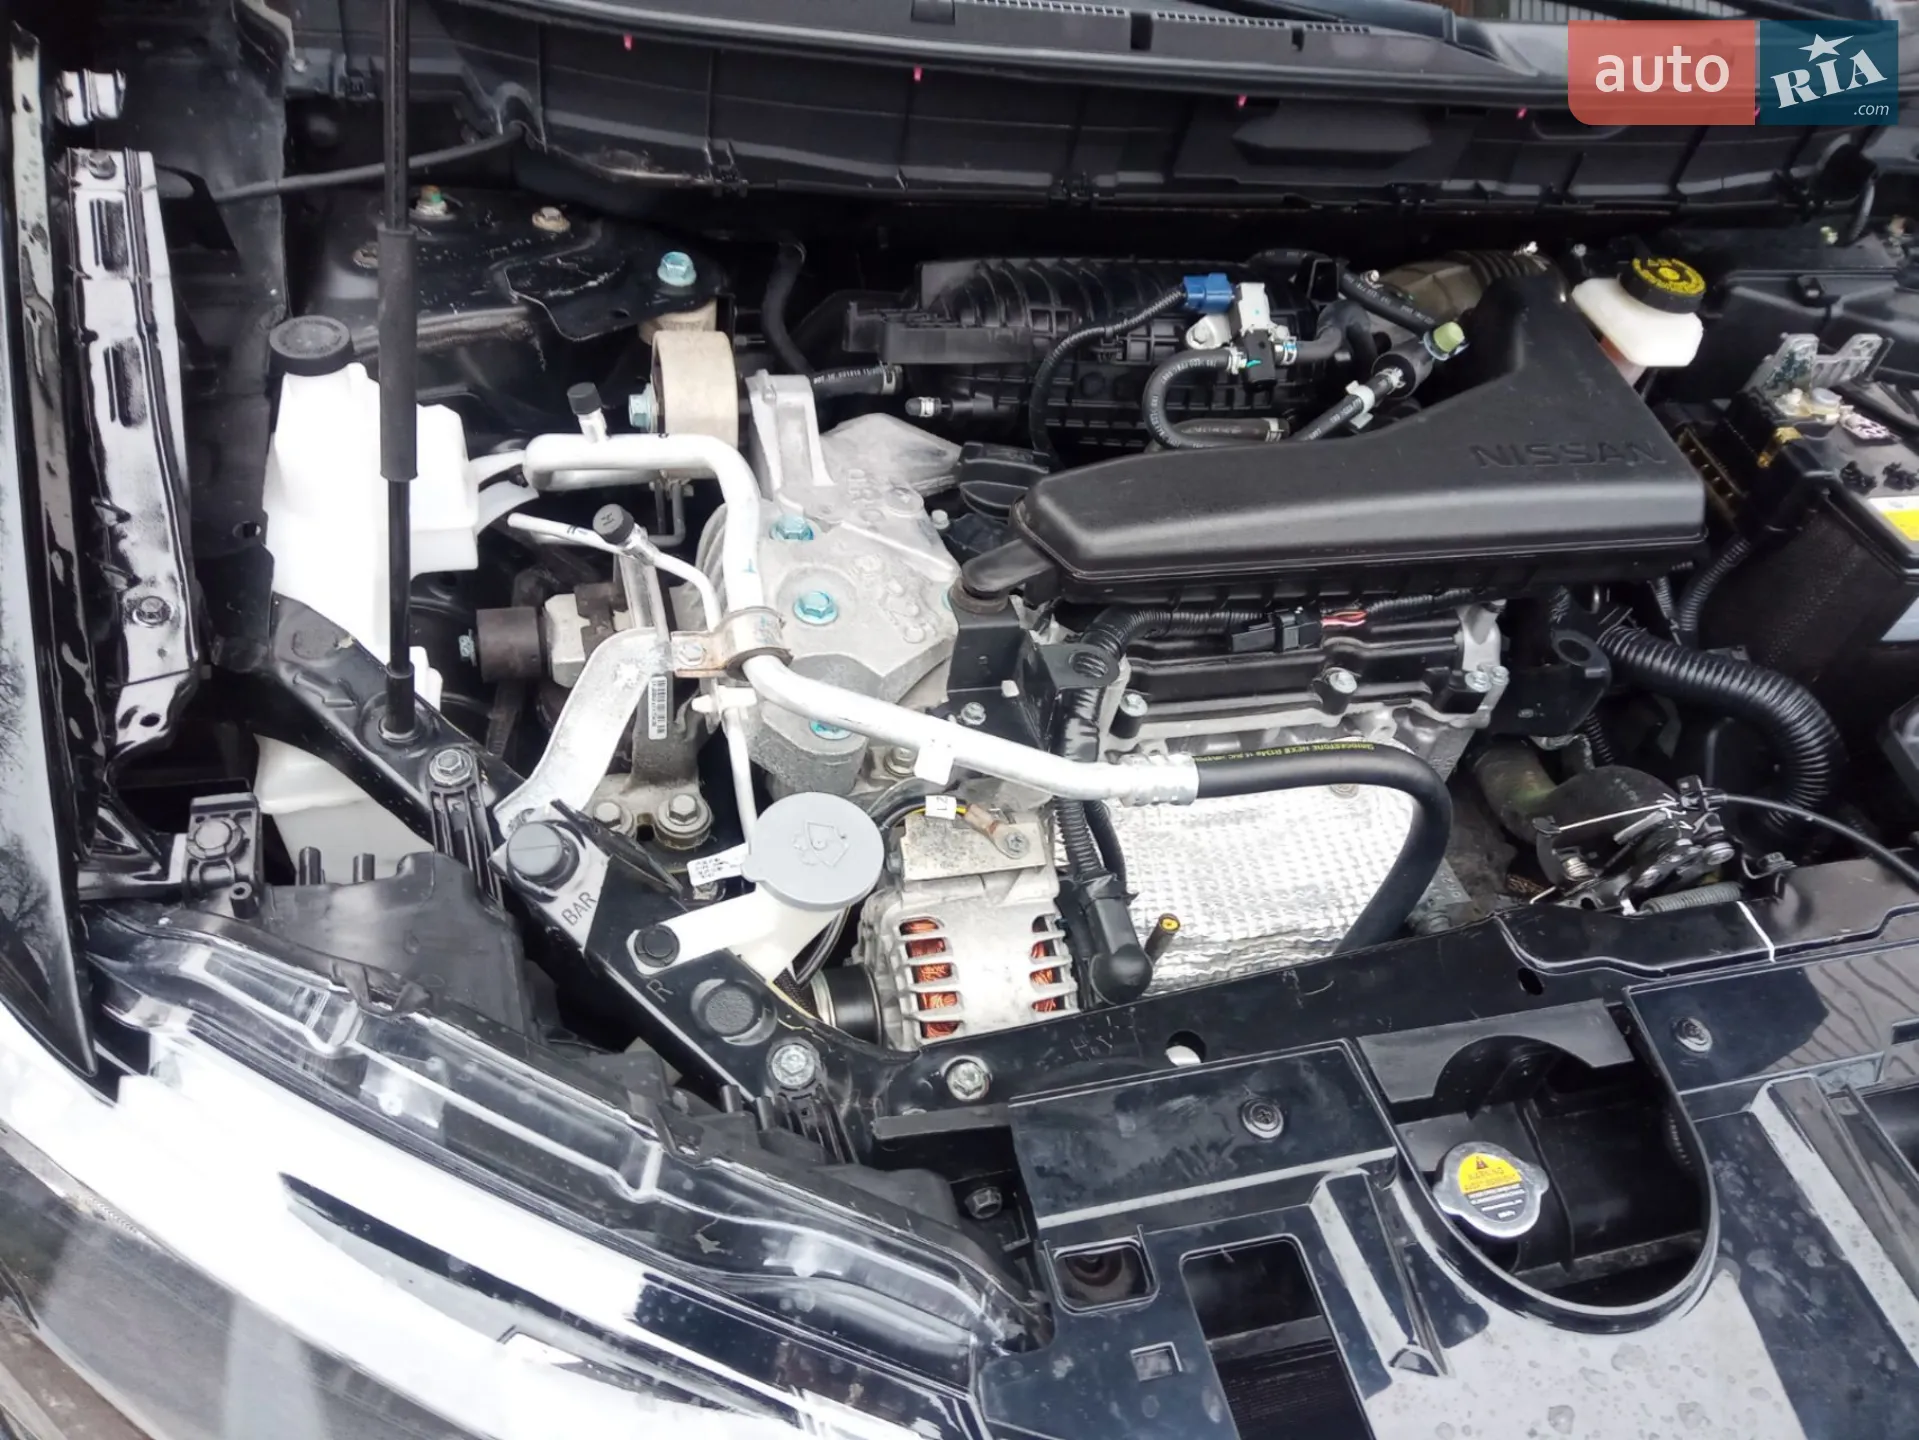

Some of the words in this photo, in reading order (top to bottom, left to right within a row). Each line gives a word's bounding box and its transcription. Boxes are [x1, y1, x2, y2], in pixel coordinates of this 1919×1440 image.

[1469, 442, 1668, 468] NISSAN
[561, 891, 598, 926] BAR
[646, 979, 674, 1004] R
